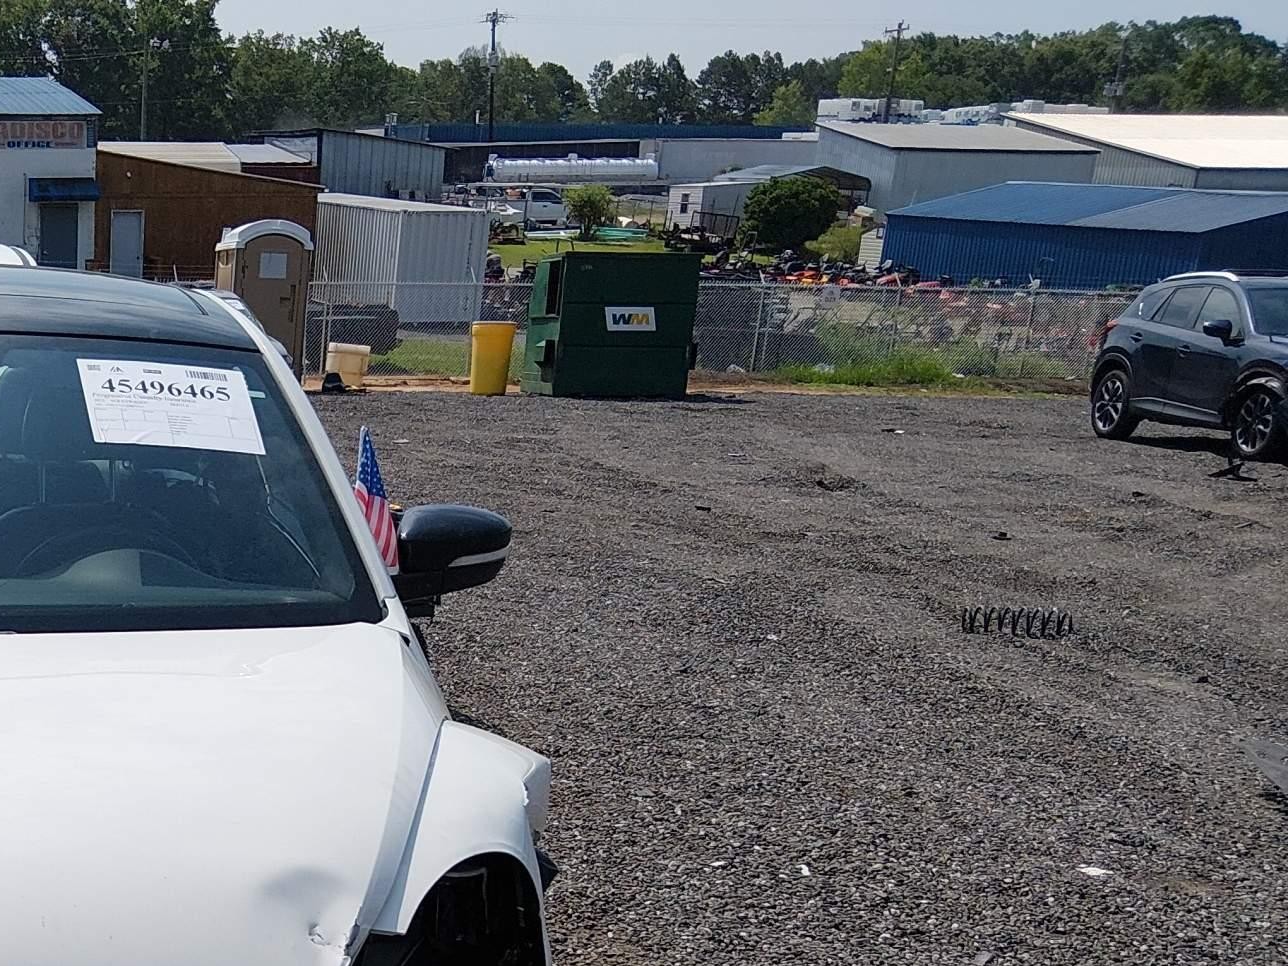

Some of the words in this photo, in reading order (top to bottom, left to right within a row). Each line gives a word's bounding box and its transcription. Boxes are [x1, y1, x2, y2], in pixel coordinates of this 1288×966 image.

[7, 140, 53, 149] OFFICE
[612, 313, 650, 325] WM
[101, 378, 231, 401] 45496465
